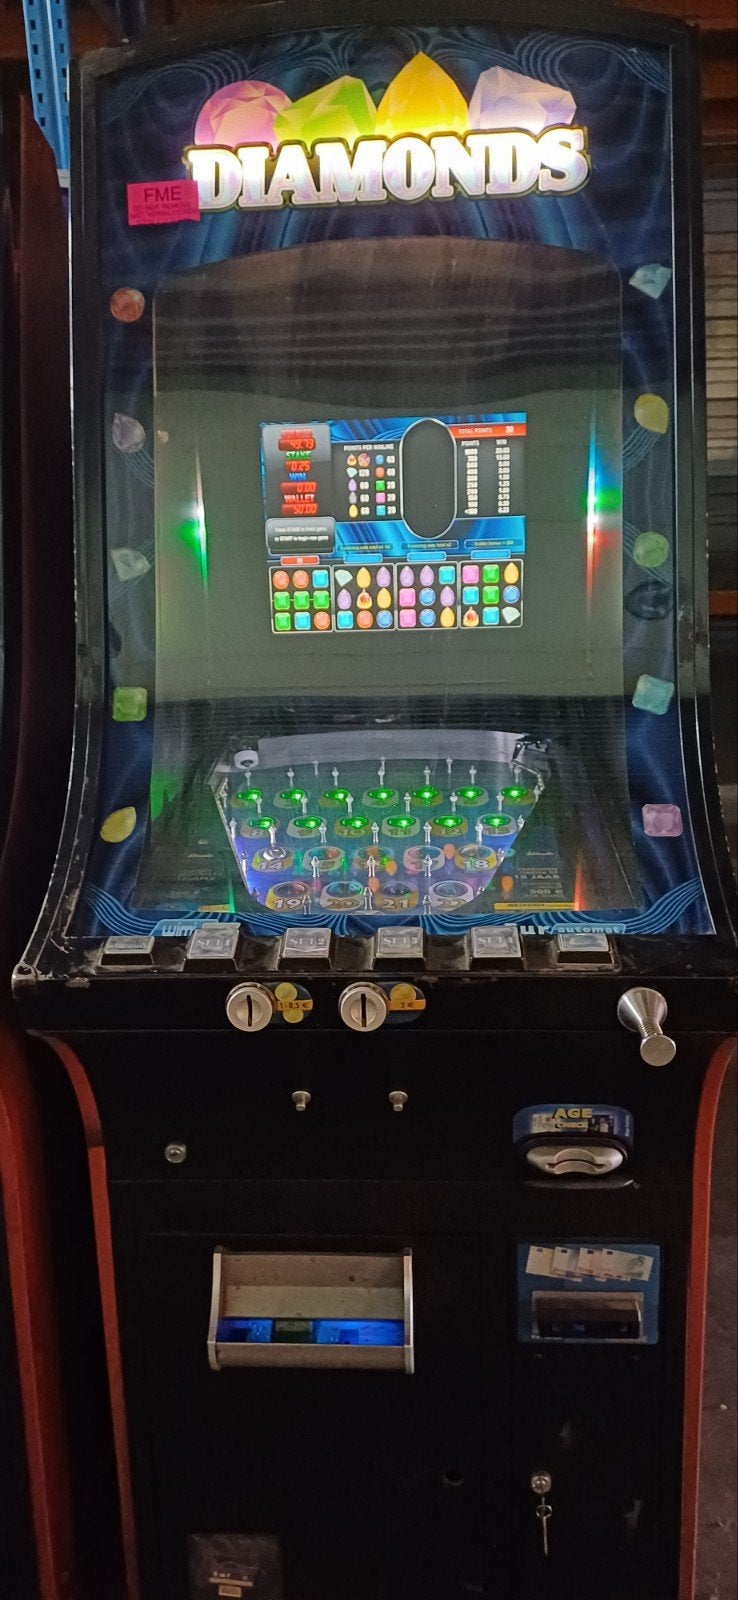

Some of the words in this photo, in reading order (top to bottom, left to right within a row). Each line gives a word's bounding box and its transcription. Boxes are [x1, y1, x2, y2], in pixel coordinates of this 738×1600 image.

[186, 127, 590, 209] DIAMONDS
[144, 186, 182, 202] FME
[285, 451, 312, 460] STAKE
[290, 461, 310, 471] 0.25
[288, 472, 307, 481] WIN
[296, 482, 317, 492] 0.00
[283, 494, 315, 503] WALLET
[292, 504, 318, 515] 50.00
[258, 860, 284, 871] 14
[462, 859, 489, 870] 18
[272, 899, 303, 910] 19
[325, 899, 361, 910] 20
[381, 898, 411, 910] 21
[553, 1107, 594, 1120] AGE
